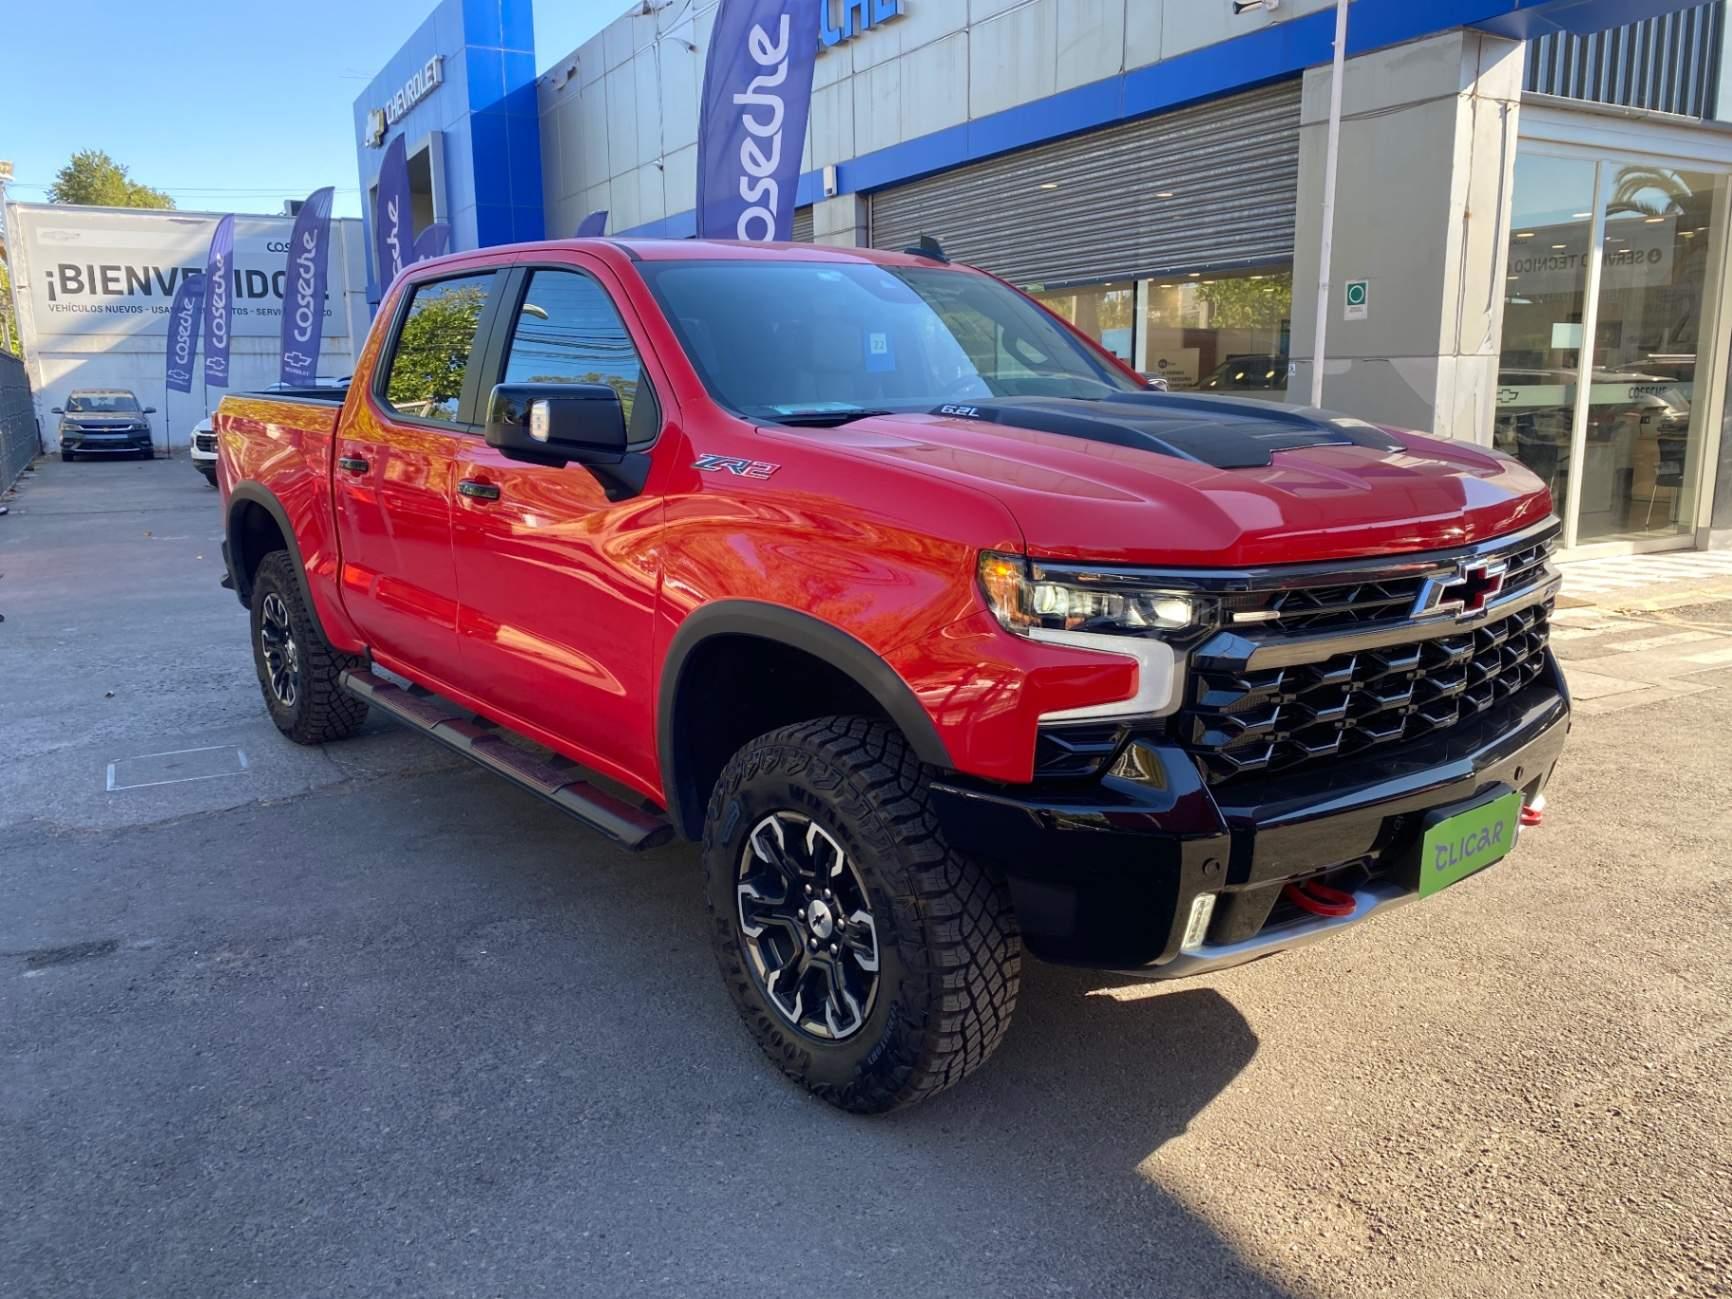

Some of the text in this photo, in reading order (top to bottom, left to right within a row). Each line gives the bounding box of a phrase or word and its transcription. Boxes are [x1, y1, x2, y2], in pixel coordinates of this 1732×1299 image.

[385, 54, 443, 125] CHEVROLET
[732, 14, 790, 241] oseche
[386, 195, 403, 278] eche
[48, 303, 103, 313] VEHÍCULOS
[105, 305, 143, 314] NUEVOS
[151, 305, 173, 314] USA
[256, 308, 281, 316] SERVI
[212, 252, 226, 349] coseche
[294, 229, 318, 342] coseche
[175, 297, 196, 364] coseche
[690, 453, 781, 480] ZR2
